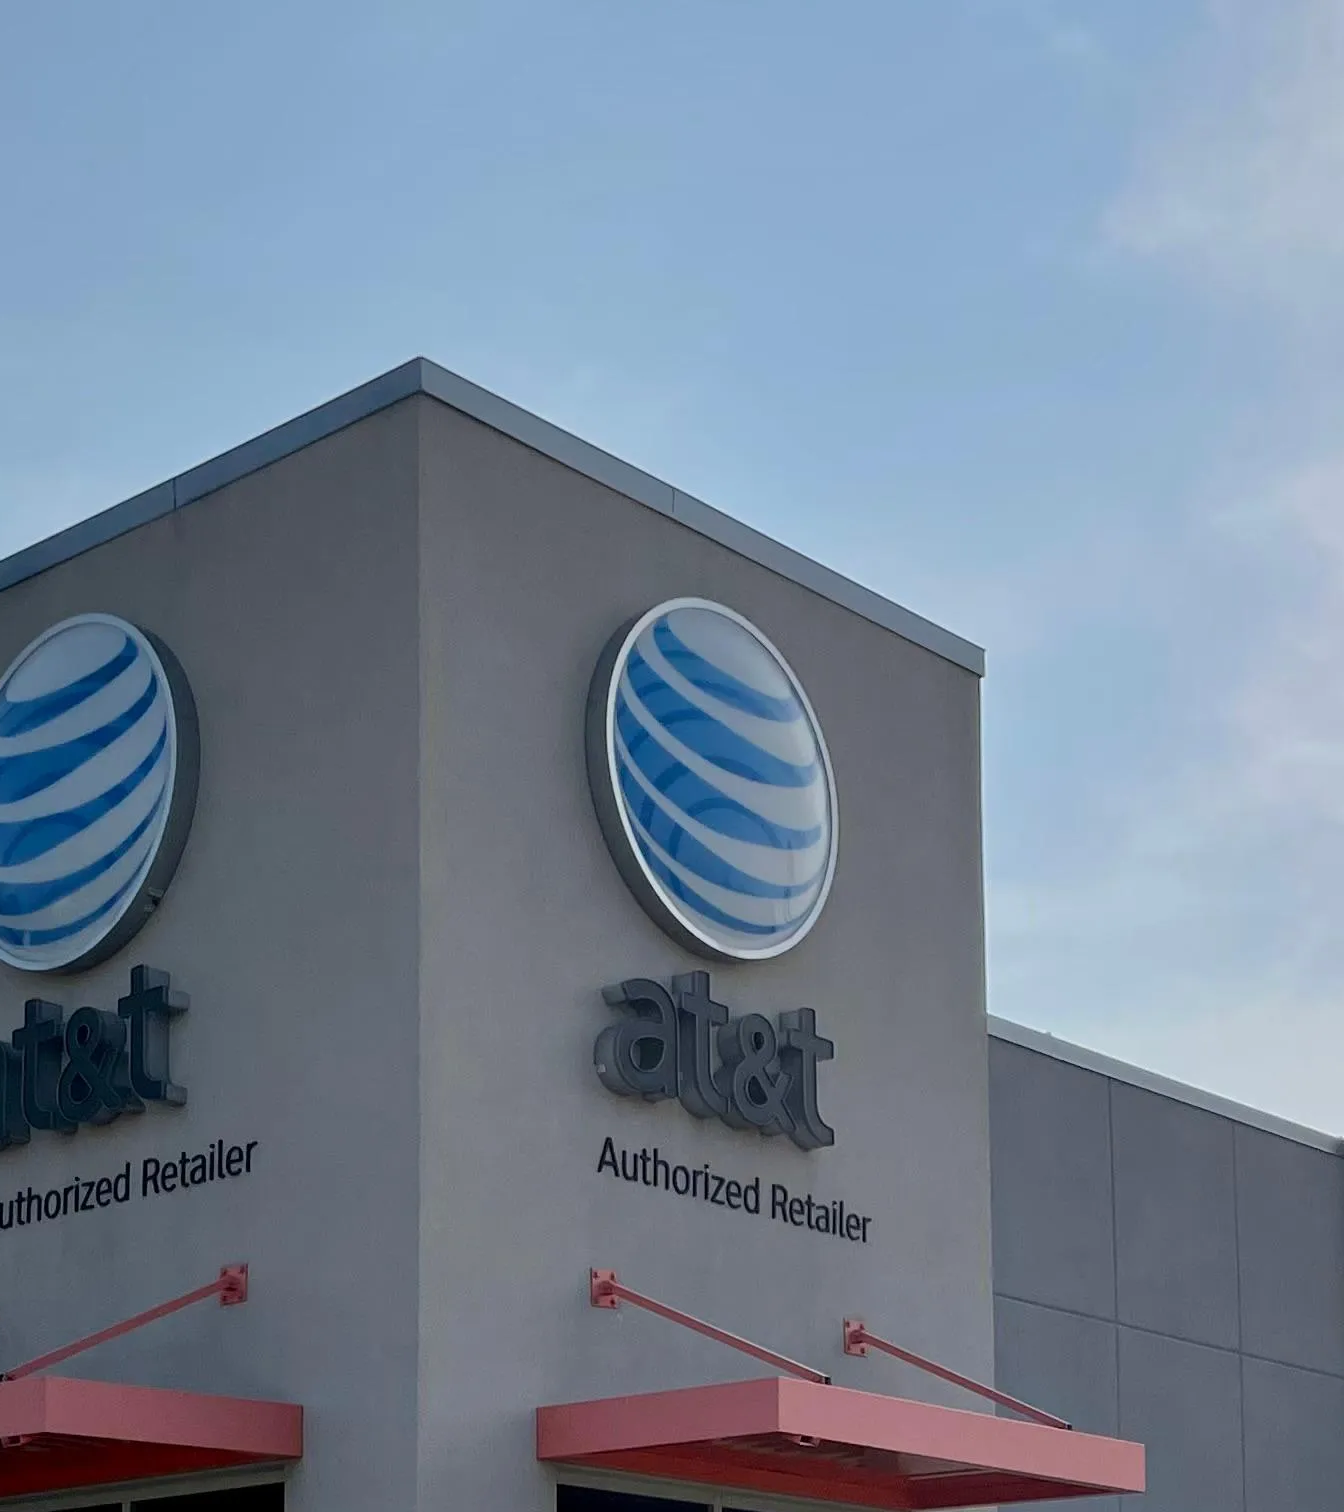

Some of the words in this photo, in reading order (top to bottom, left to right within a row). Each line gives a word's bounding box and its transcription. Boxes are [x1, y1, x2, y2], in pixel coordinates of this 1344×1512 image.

[594, 970, 835, 1150] at&t
[141, 1139, 258, 1198] Retailer
[597, 1136, 761, 1214] Authorized
[770, 1183, 872, 1243] Retailer
